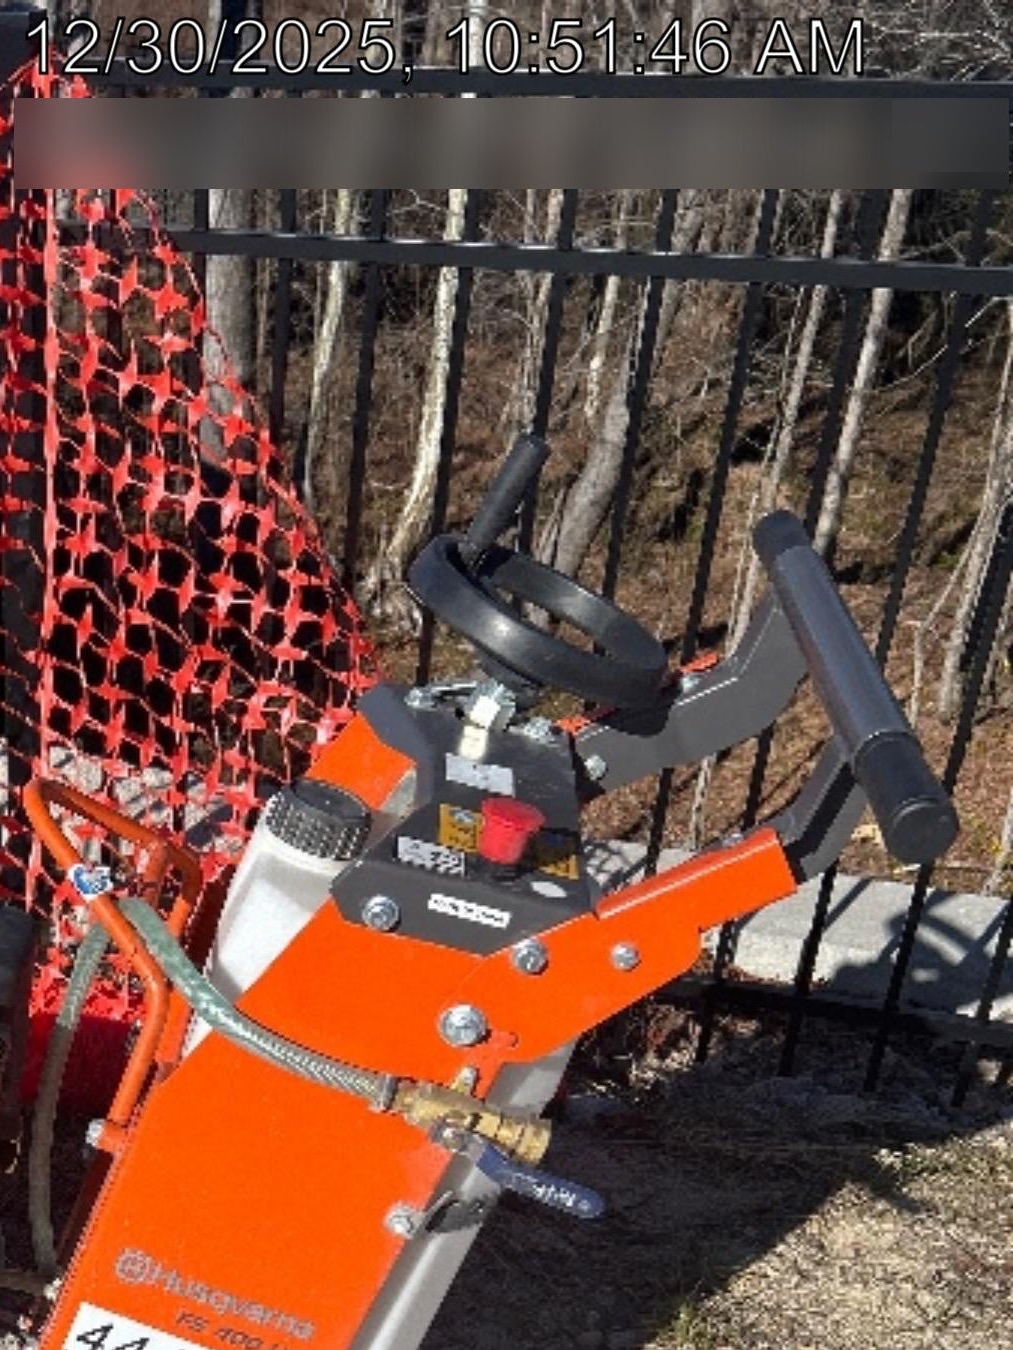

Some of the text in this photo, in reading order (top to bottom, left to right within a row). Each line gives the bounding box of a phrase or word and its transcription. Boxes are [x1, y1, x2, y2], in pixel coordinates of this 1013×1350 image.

[146, 1257, 316, 1341] Husqvarna
[176, 1310, 209, 1332] FS
[215, 1326, 263, 1350] 400
